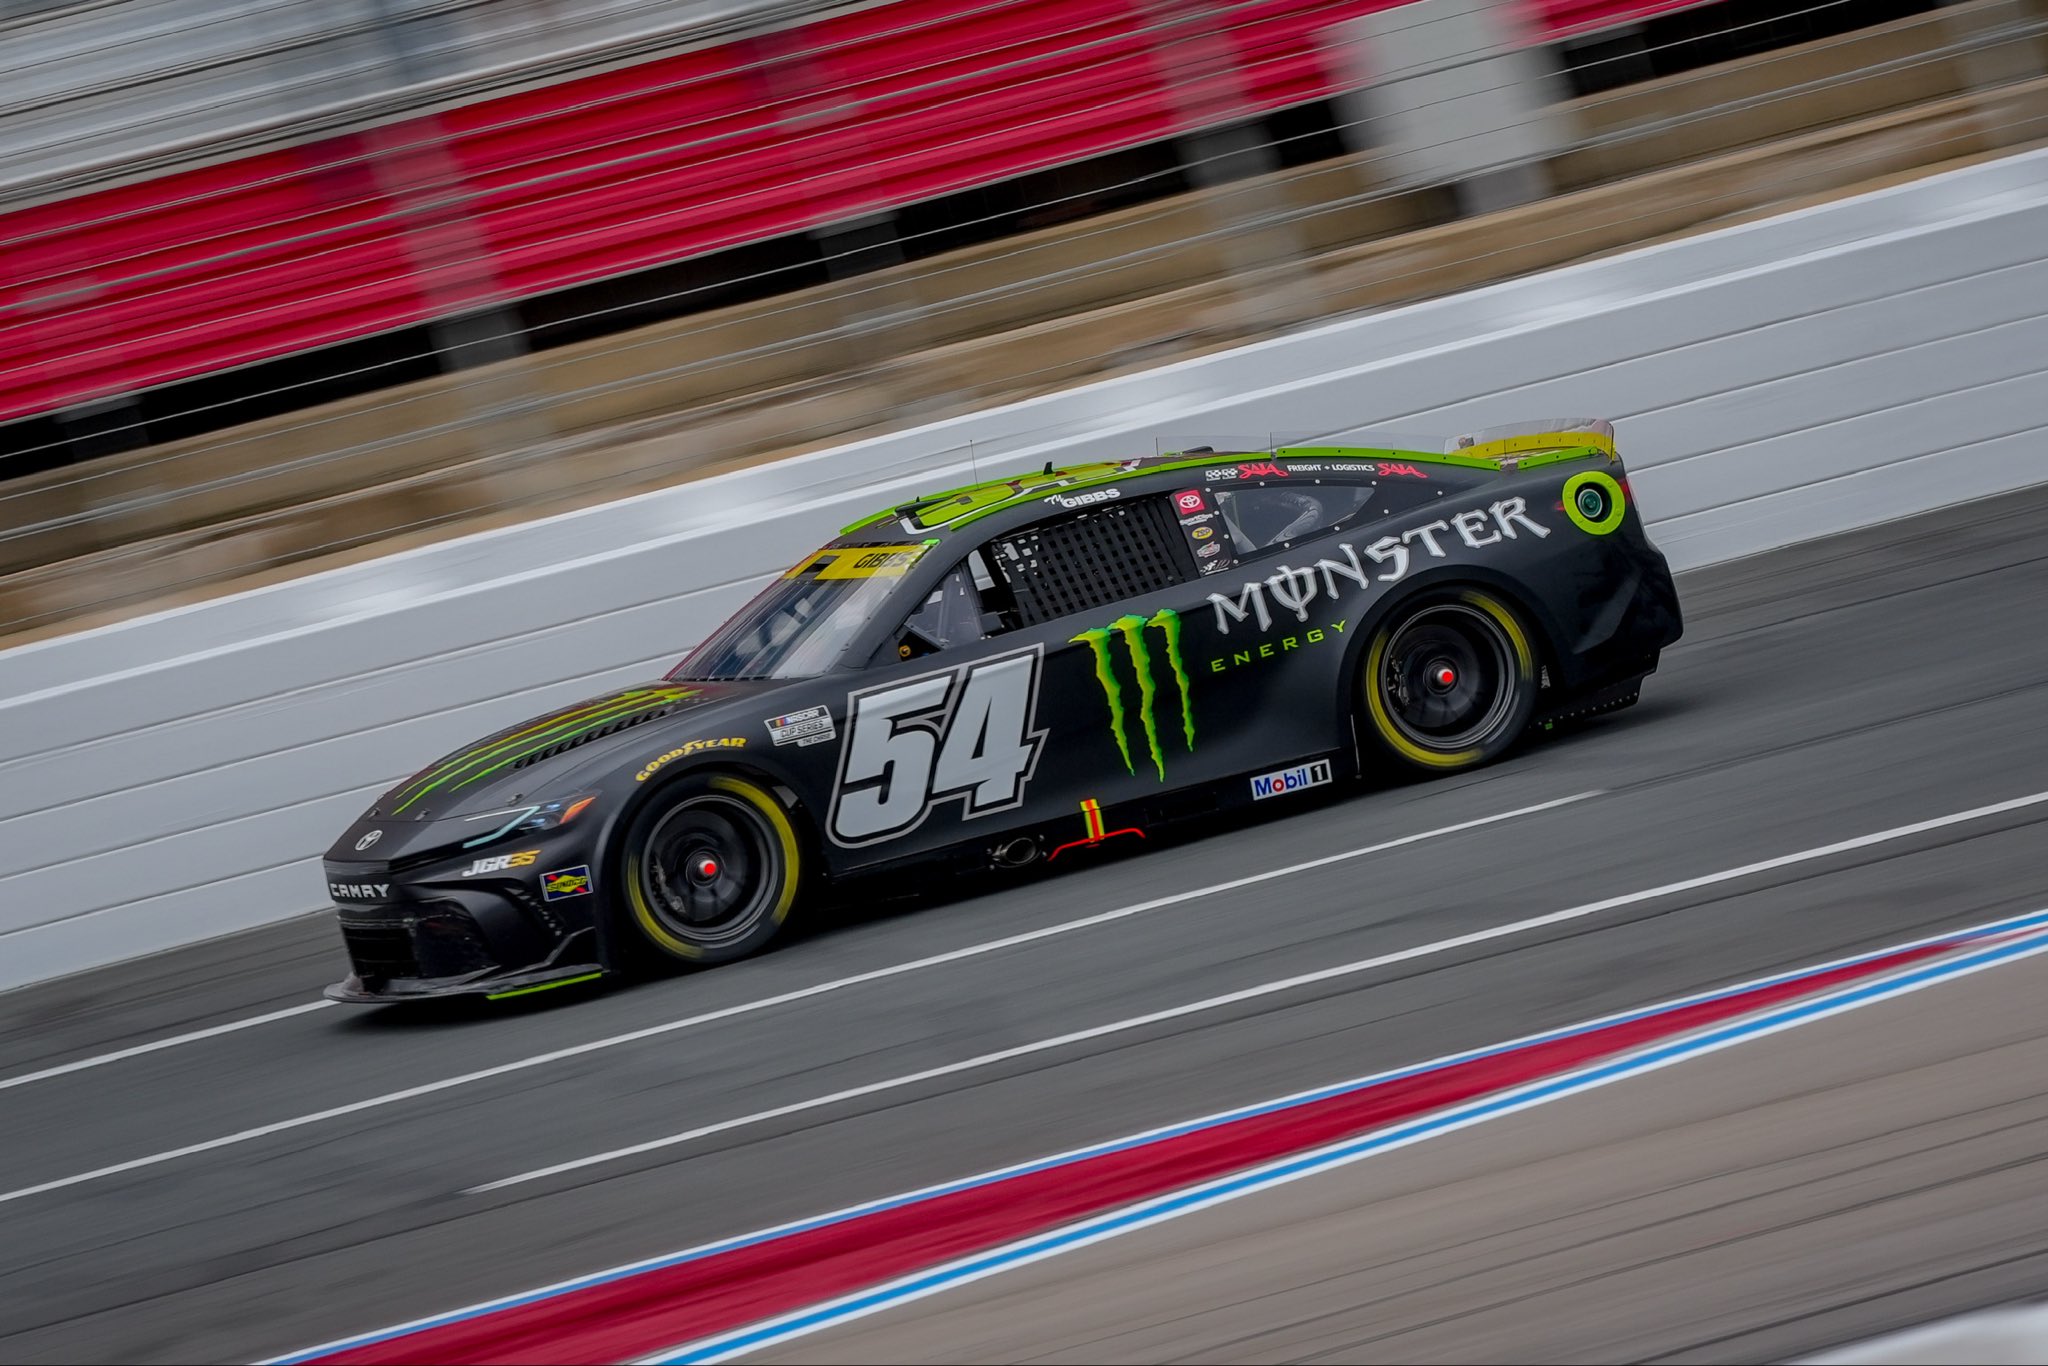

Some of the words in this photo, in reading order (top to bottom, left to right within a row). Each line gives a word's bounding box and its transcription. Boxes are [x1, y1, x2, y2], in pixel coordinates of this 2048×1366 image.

[1238, 463, 1288, 479] SAIA
[1287, 464, 1321, 472] FREIGHT
[1332, 464, 1375, 472] LOGISTICS
[1377, 463, 1428, 479] SAIA
[1061, 488, 1120, 508] GIBBS
[1211, 619, 1346, 672] ENERGY
[784, 709, 820, 724] NASCAR
[780, 727, 796, 738] CUP
[797, 720, 824, 734] SERIES
[802, 737, 812, 745] THE
[829, 647, 1044, 845] 54
[635, 737, 747, 782] GOODYEAR
[1254, 768, 1308, 797] Mobil
[1314, 765, 1323, 781] 1
[329, 882, 391, 899] CAMRY
[545, 876, 589, 893] SUNOCO
